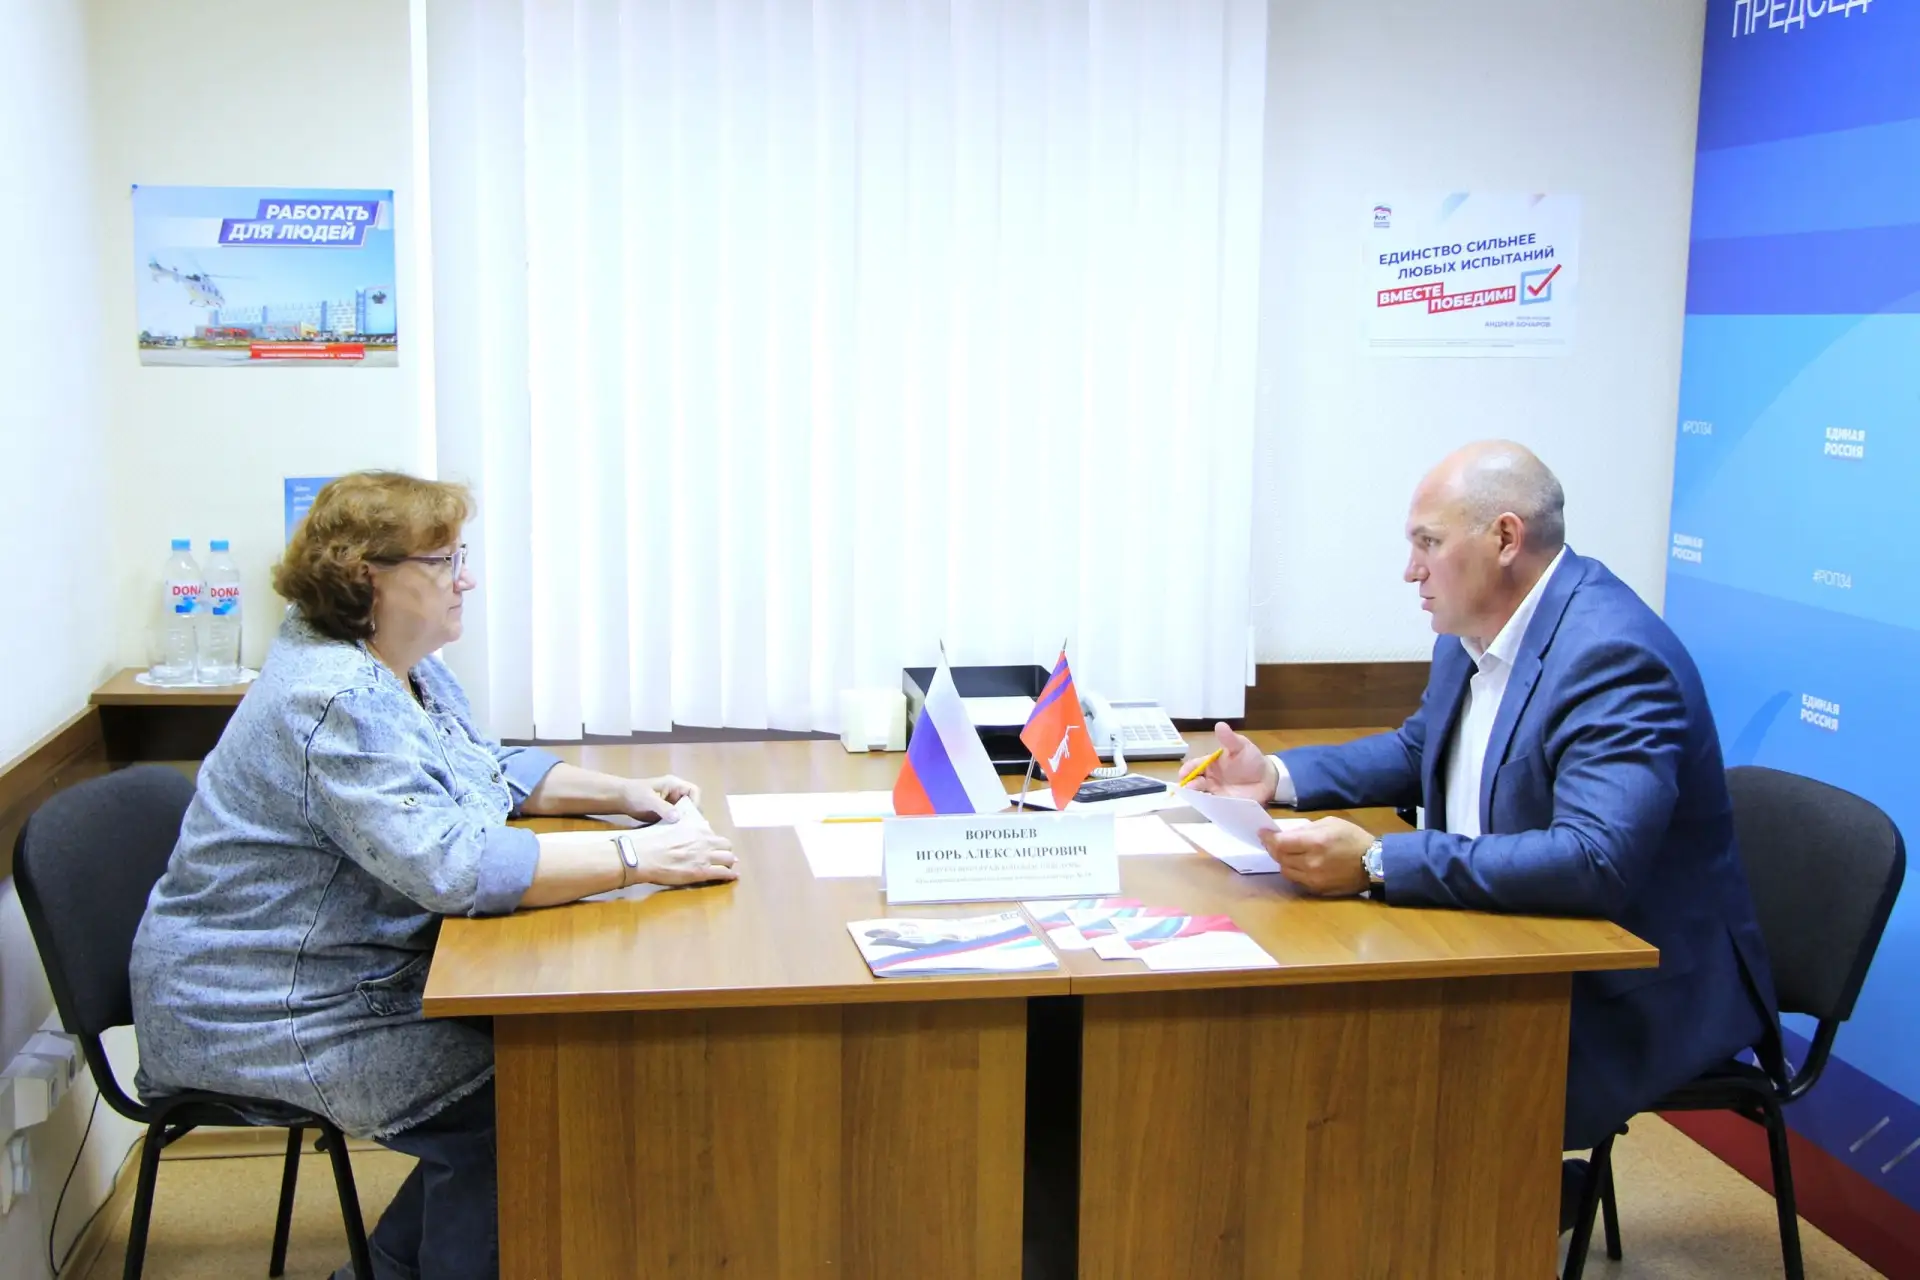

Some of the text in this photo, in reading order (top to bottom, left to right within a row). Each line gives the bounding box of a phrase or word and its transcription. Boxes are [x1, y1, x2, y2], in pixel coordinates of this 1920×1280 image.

[266, 204, 369, 220] РАБОТАТЬ
[228, 222, 356, 242] ДЛЯ ЛЮДЕЙ
[1379, 233, 1536, 266] ЕДИНСТВО СИЛЬНЕЕ
[1398, 245, 1555, 280] ЛЮБЫХ ИСПЫТАНИЙ
[1379, 284, 1442, 304] ВМЕСТЕ
[1431, 288, 1513, 311] ПОБЕДИМ!
[1826, 427, 1865, 441] ЕДИНАЯ
[1824, 442, 1864, 458] РОССИЯ
[1672, 546, 1702, 564] РОССИЯ
[1812, 569, 1852, 589] #РОП34
[210, 588, 240, 598] DONA
[1802, 693, 1840, 715] ЕДИНАЯ
[1800, 708, 1838, 732] РОССИЯ
[965, 828, 1037, 840] ВОРОБЬЕВ
[916, 845, 1087, 861] ИГОРЬ АЛЕКСАНДРОВИЧ
